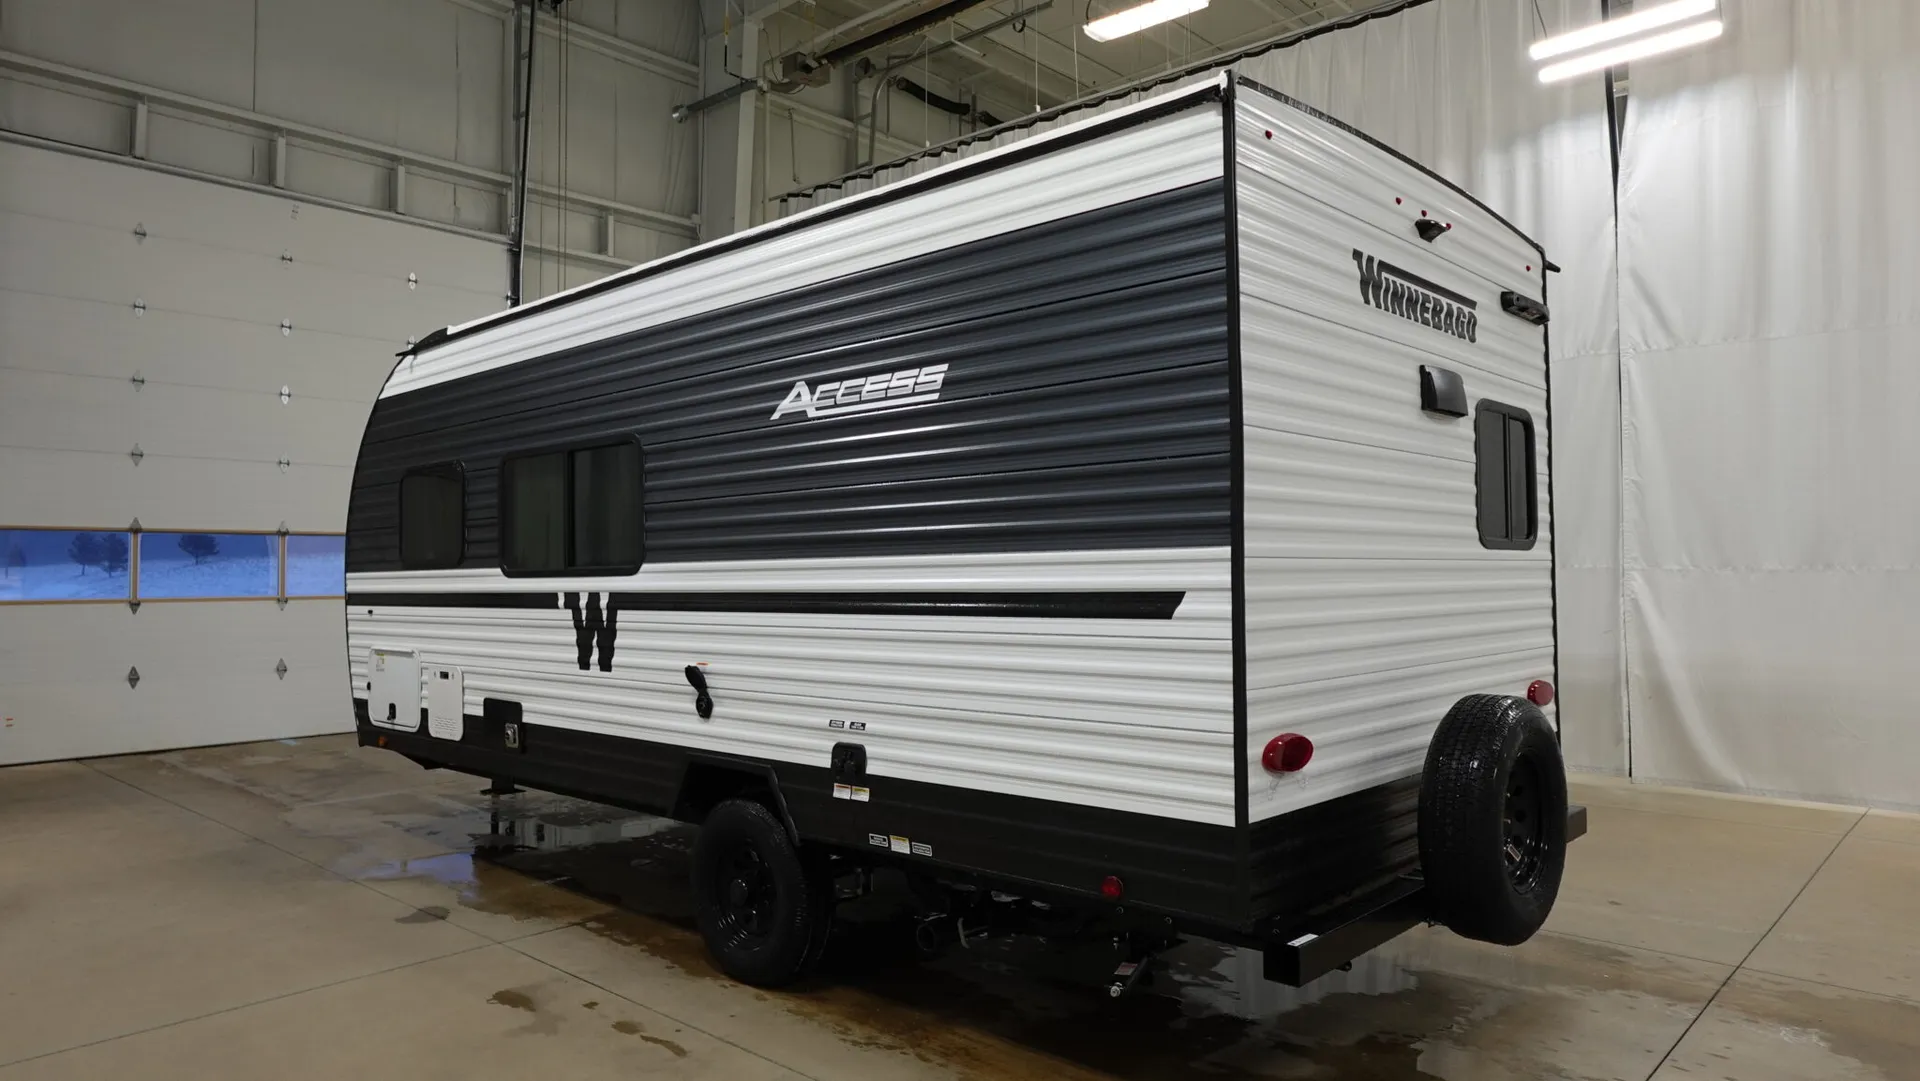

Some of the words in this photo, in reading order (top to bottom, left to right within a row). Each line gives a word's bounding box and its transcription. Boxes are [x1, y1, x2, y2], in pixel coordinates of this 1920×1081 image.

[1352, 248, 1477, 343] WINNEBAGO
[769, 363, 950, 420] ACCESS
[563, 592, 618, 673] W
